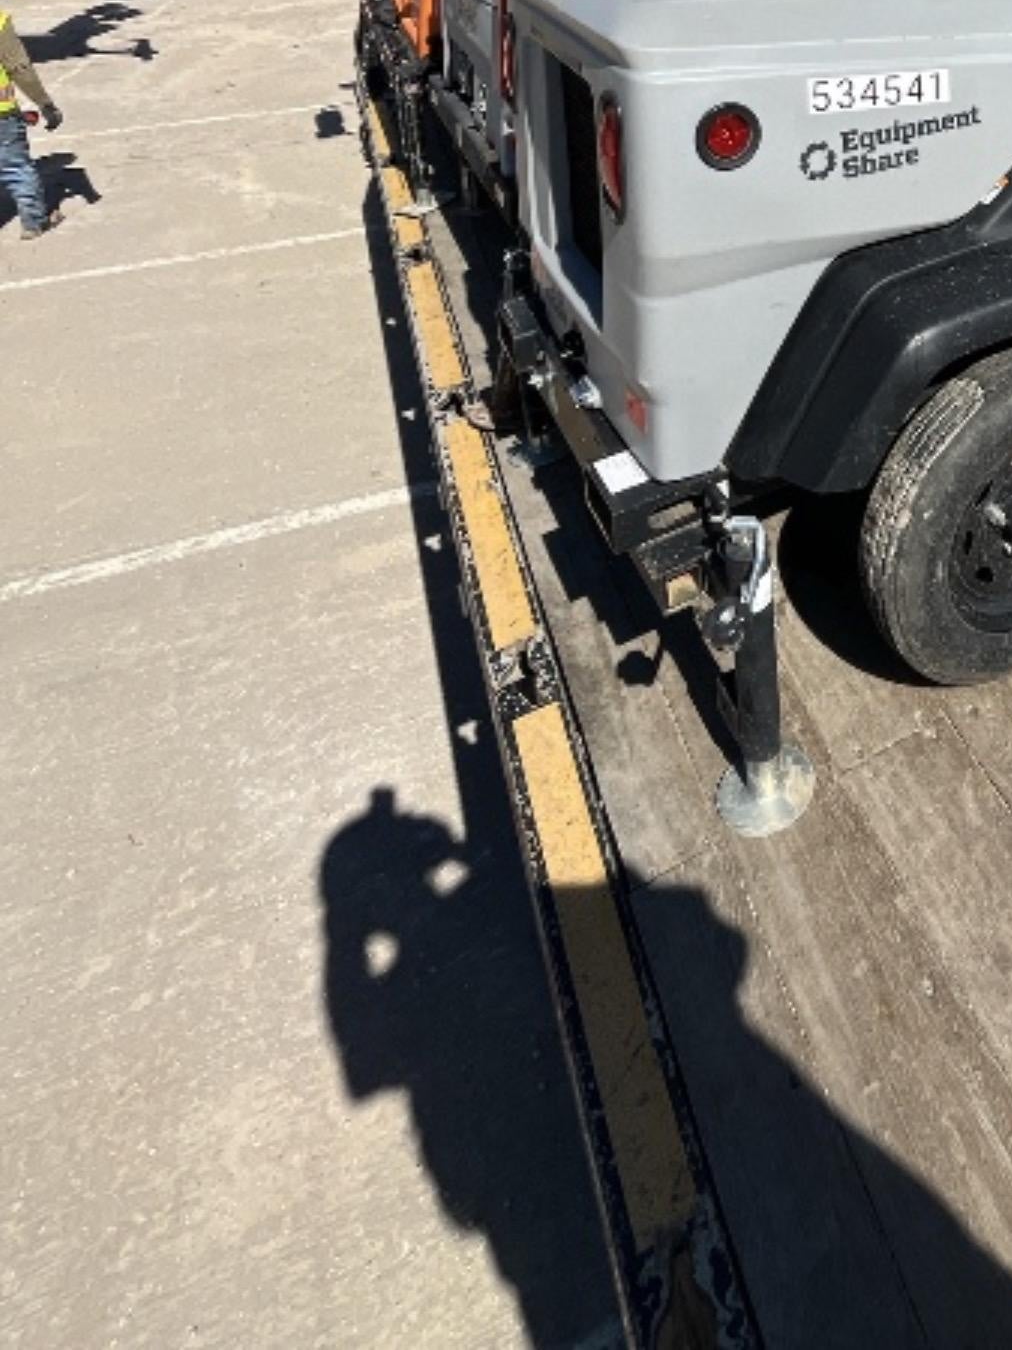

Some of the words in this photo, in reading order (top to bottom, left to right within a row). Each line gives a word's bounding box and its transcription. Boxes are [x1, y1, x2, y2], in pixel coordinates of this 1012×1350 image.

[812, 71, 941, 112] 534541
[840, 104, 982, 153] Equipment
[842, 147, 920, 179] Share
